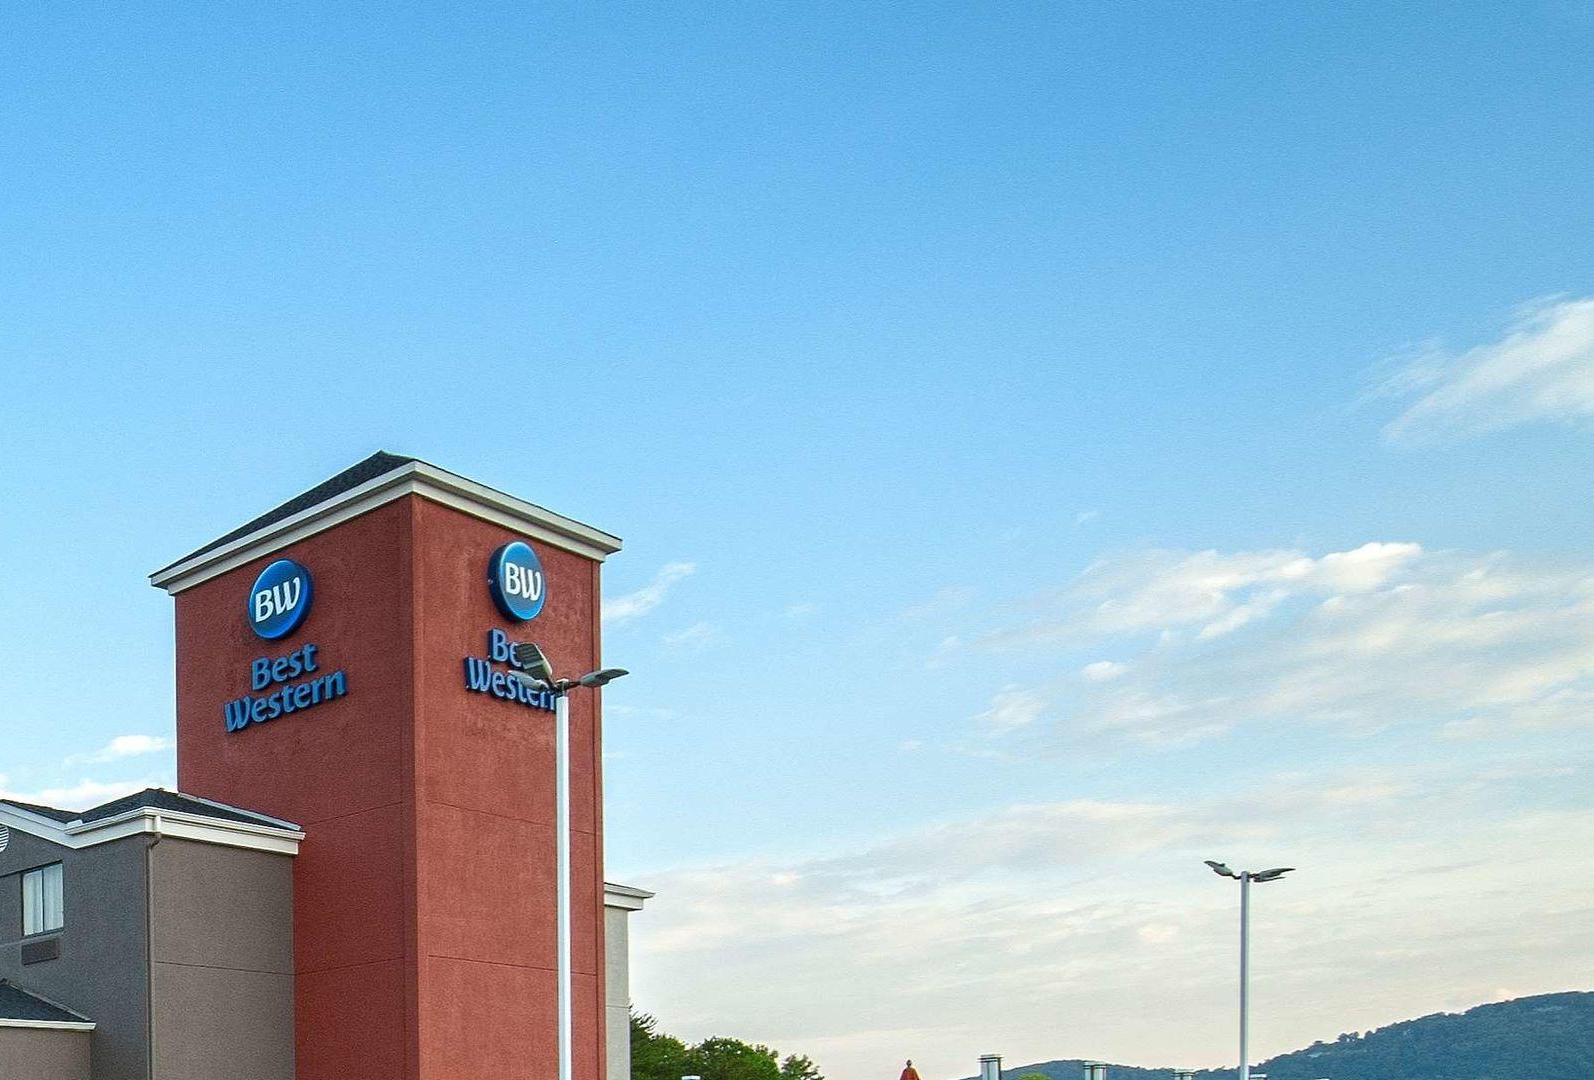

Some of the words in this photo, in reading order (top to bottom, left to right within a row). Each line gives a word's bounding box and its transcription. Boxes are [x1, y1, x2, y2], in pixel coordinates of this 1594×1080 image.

[255, 576, 301, 623] BW
[505, 562, 542, 601] BW
[250, 642, 319, 691] Best
[223, 669, 348, 733] Western
